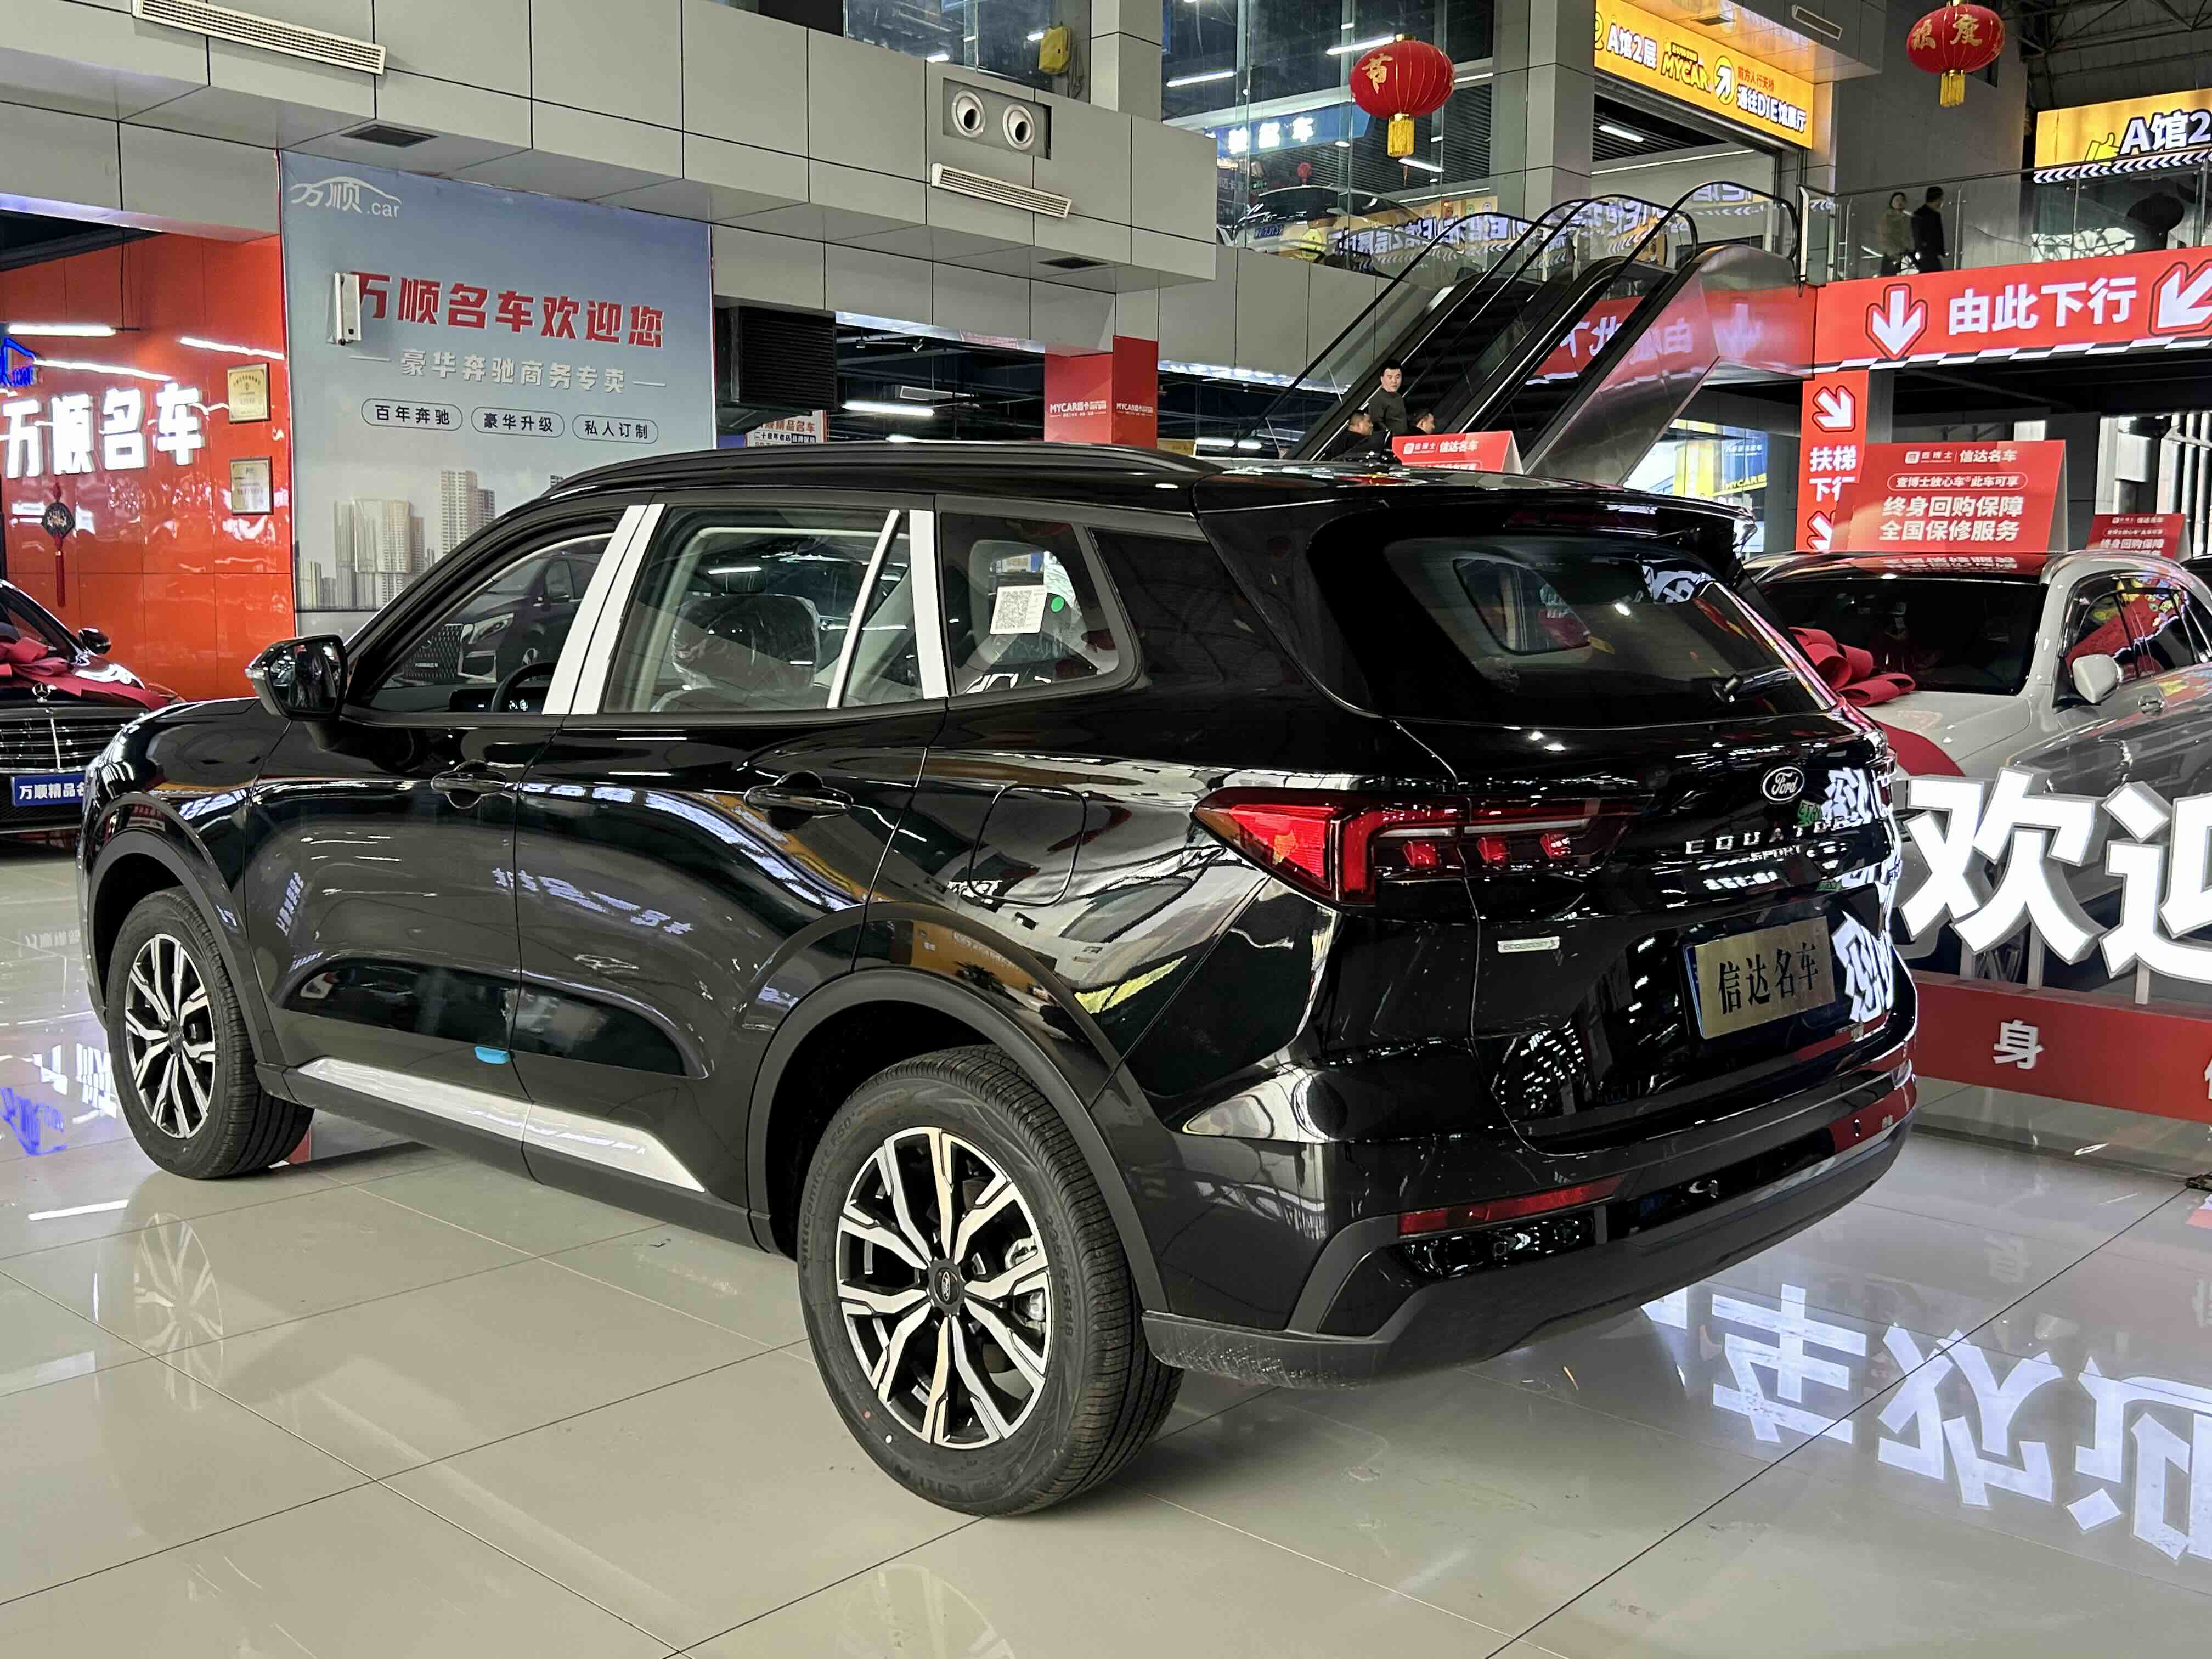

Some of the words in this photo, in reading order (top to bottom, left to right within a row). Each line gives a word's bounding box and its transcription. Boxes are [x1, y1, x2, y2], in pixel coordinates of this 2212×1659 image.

[1661, 52, 1711, 93] MYCAR
[351, 271, 665, 348] 万顺名车欢迎您
[1948, 276, 2137, 335] 由此下行
[400, 349, 625, 394] 豪华奔驰商务专卖
[2, 382, 204, 479] 万顺名车
[375, 404, 451, 426] 百年奔驰
[483, 412, 554, 433] 豪华升级
[584, 420, 648, 439] 私人订制
[1809, 445, 1857, 472] 扶梯
[1959, 449, 2018, 464] 信达名车
[1881, 495, 2024, 518] 终身回购保障
[1878, 520, 2020, 542] 全国保修服务
[1685, 817, 1854, 854] EQUATOR
[1718, 943, 1819, 1014] 信达名车
[1993, 1020, 2044, 1070] 身
